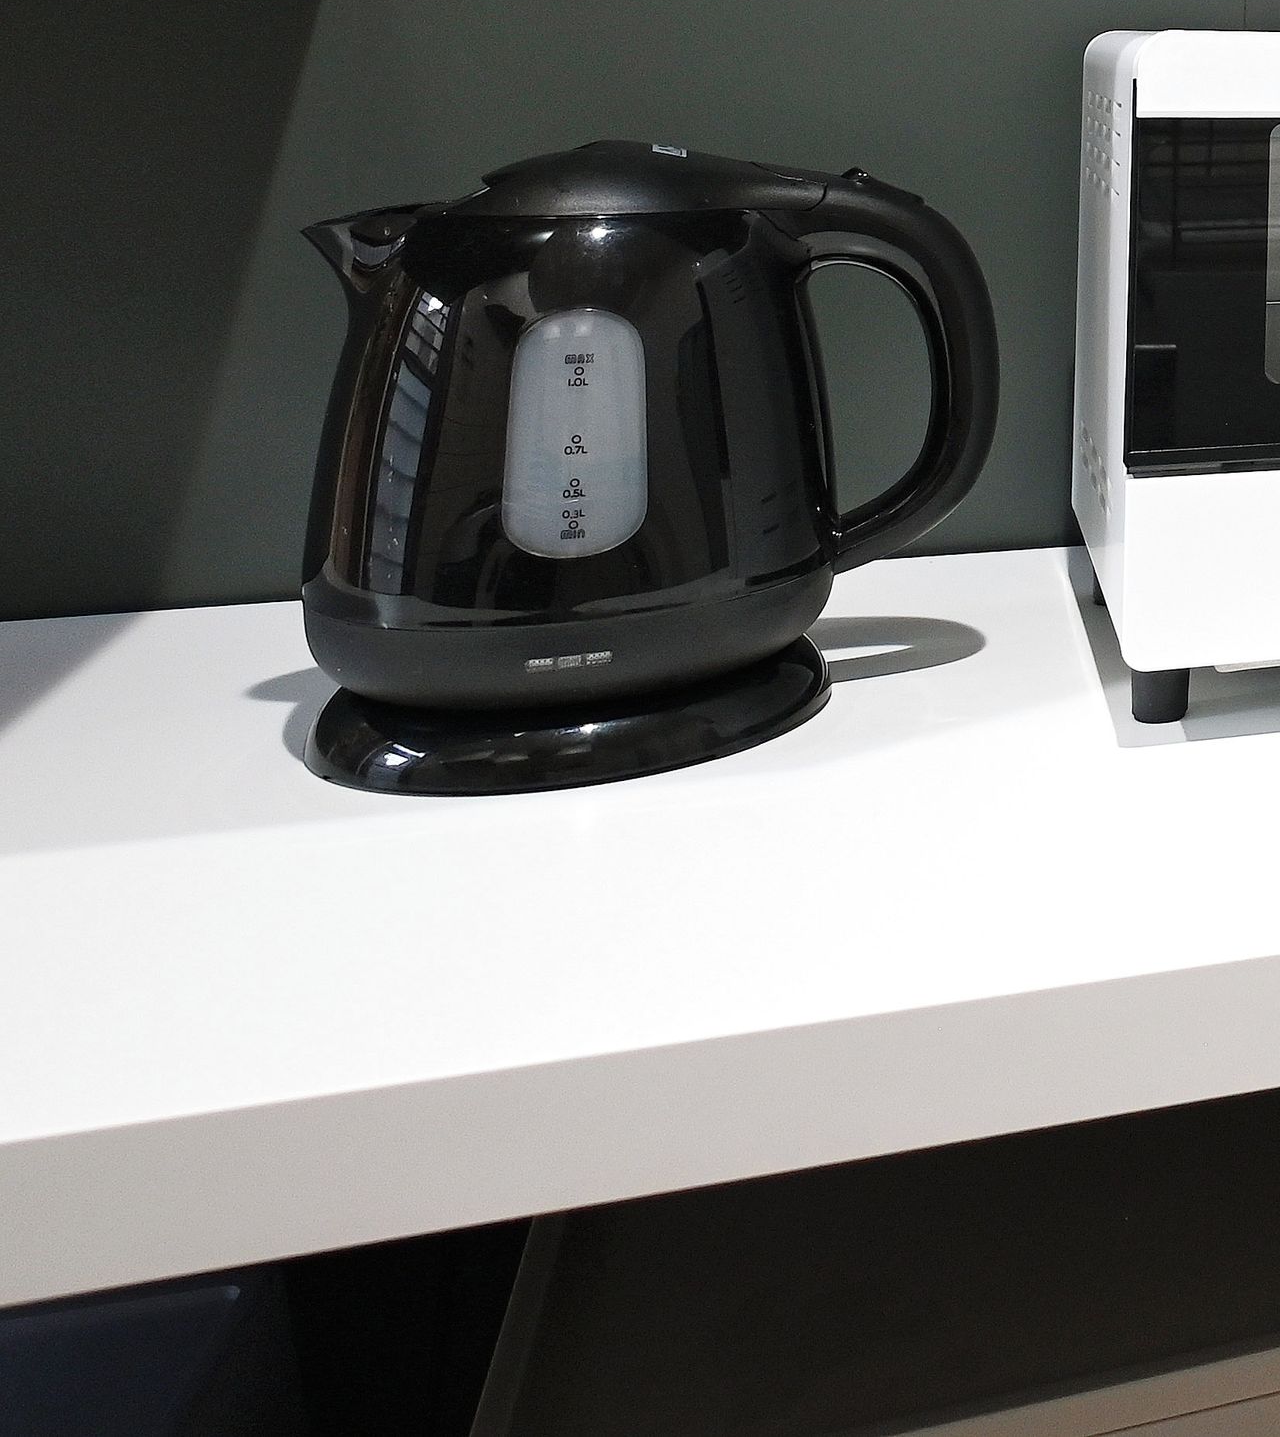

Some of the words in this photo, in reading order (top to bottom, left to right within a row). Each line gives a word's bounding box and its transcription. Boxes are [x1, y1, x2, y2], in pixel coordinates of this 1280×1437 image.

[568, 377, 589, 387] 1.0L
[564, 446, 588, 455] 0.7L
[562, 489, 586, 498] 0.5L
[562, 509, 586, 519] 0.3L
